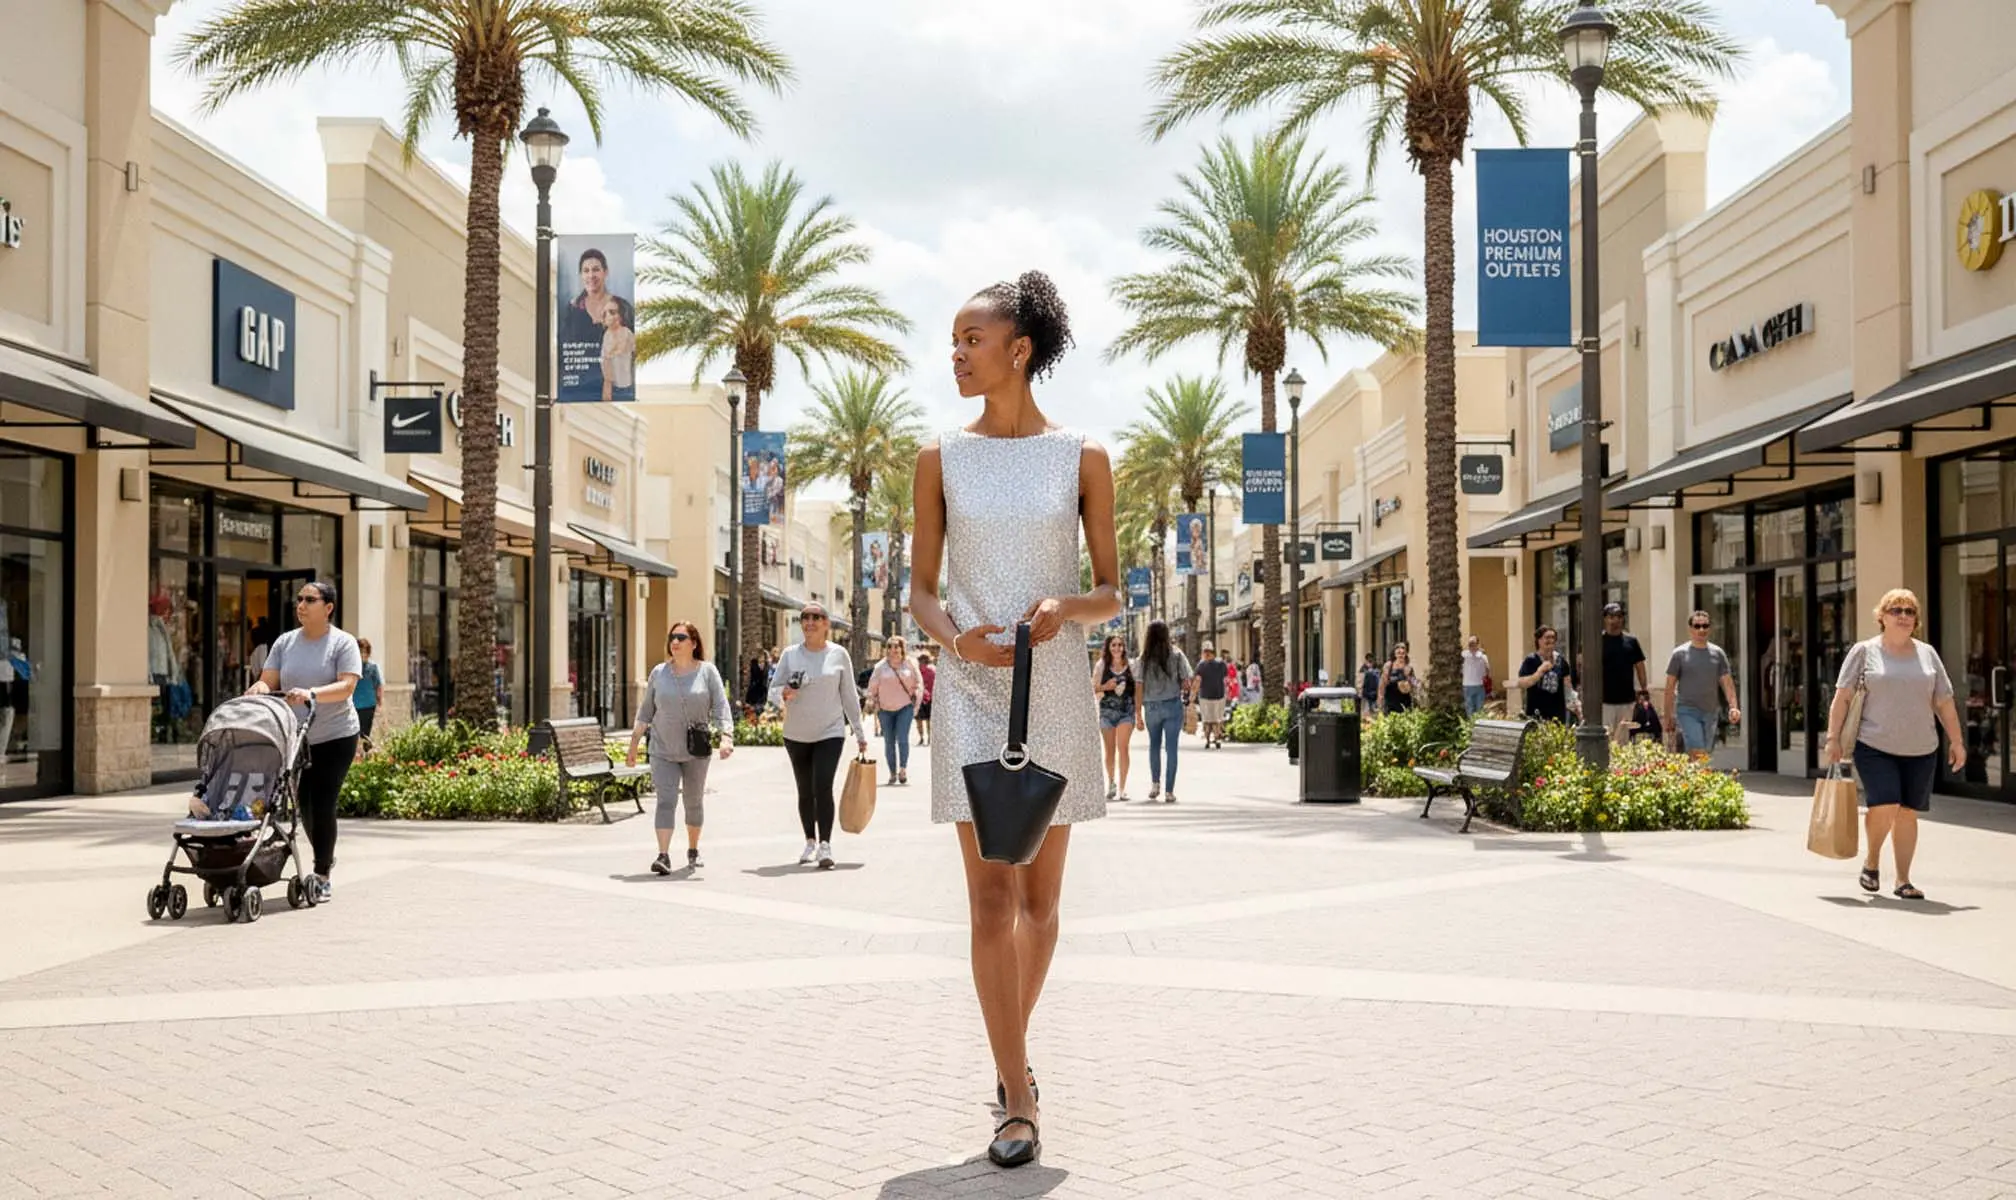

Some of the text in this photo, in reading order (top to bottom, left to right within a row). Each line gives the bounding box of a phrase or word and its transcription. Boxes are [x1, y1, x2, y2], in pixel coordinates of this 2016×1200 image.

[1484, 228, 1562, 244] HOUSTON
[1485, 245, 1562, 261] PREMIUM
[1485, 262, 1561, 278] OUTLETS
[240, 305, 286, 371] GAP
